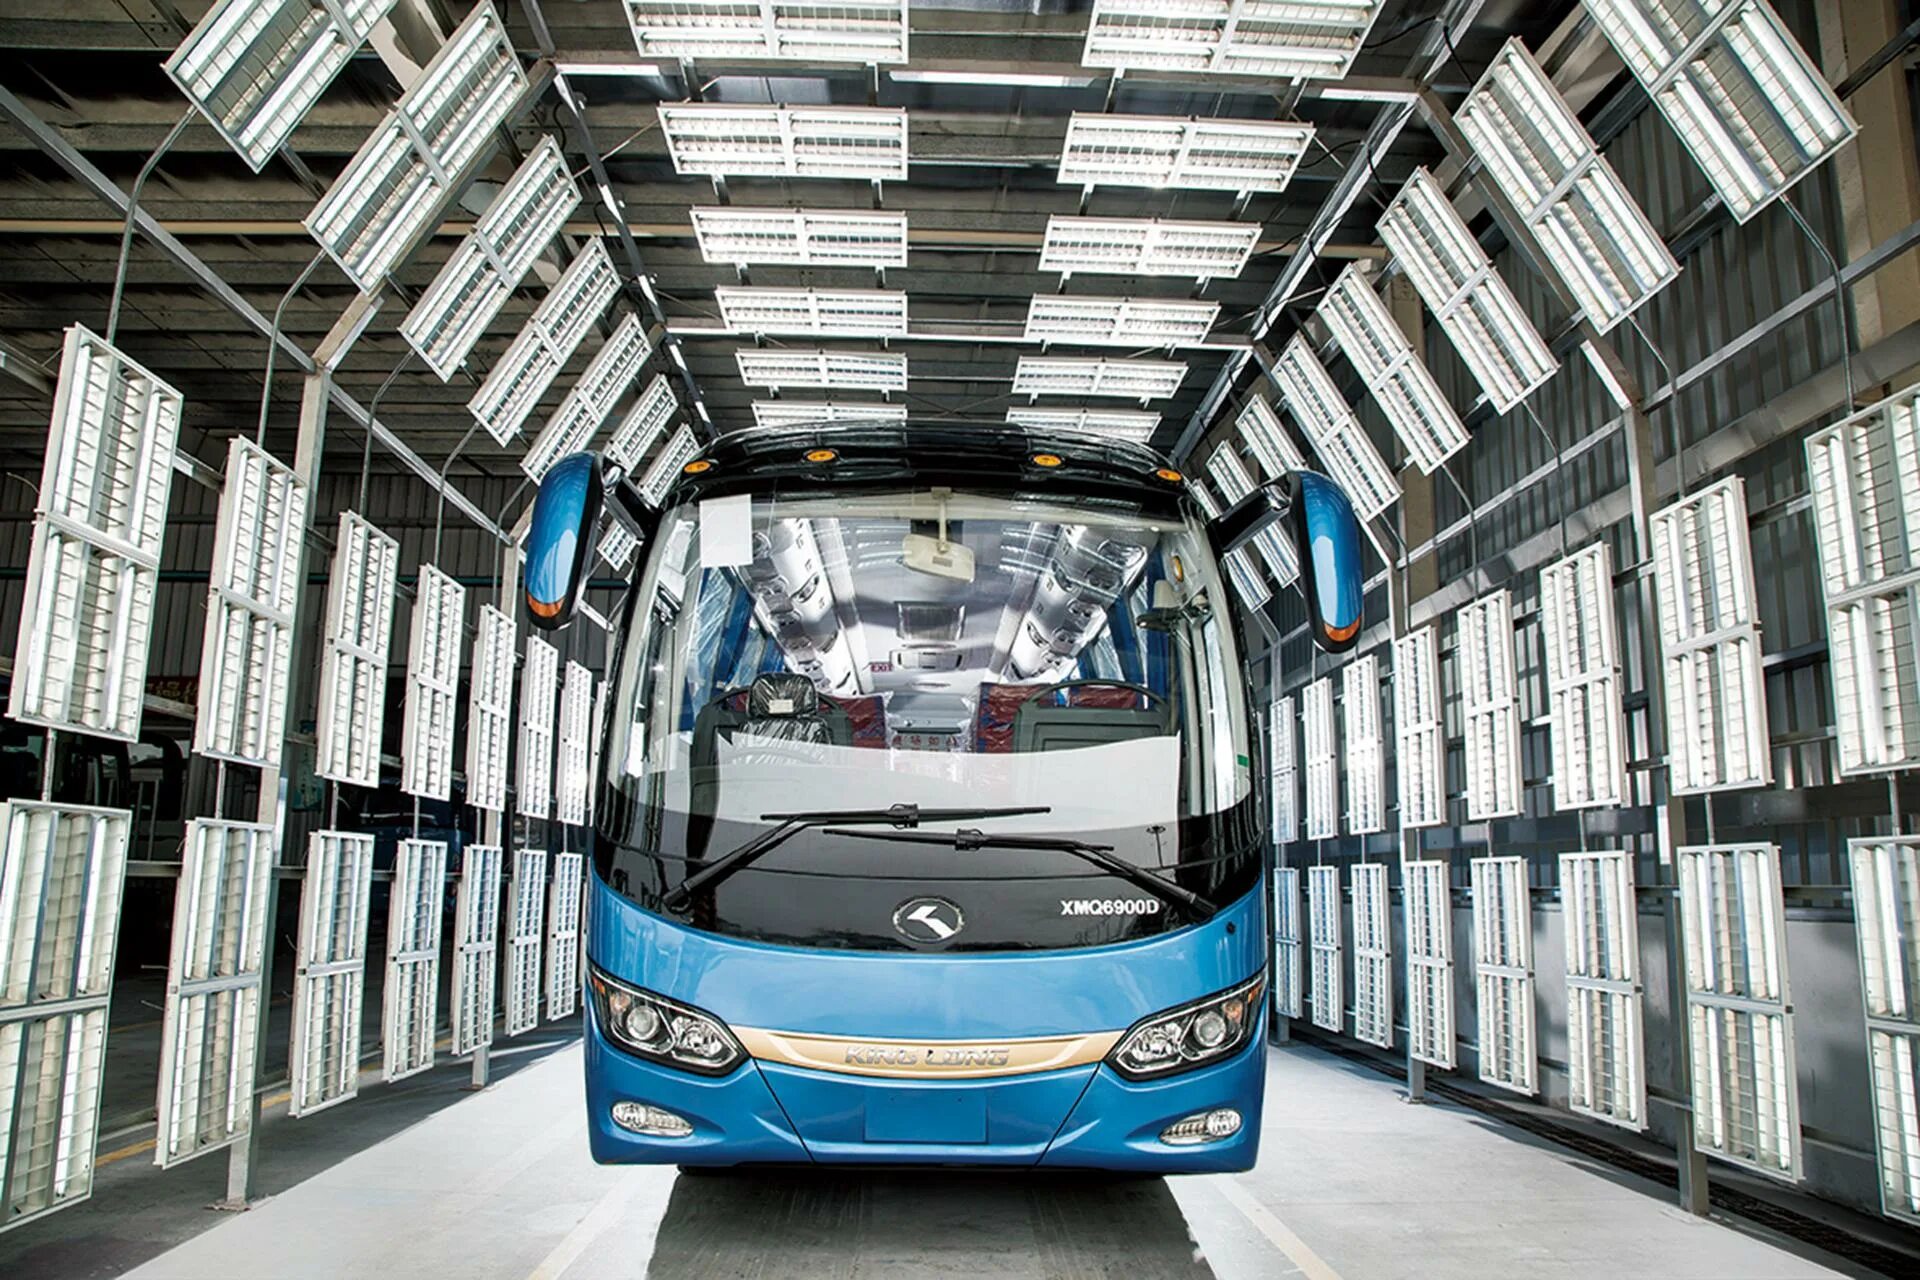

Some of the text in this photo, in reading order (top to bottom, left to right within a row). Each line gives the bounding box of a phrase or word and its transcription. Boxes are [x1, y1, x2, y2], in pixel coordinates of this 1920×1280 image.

[1060, 899, 1159, 916] XMQ6900D
[845, 1046, 1009, 1066] KING LONG
